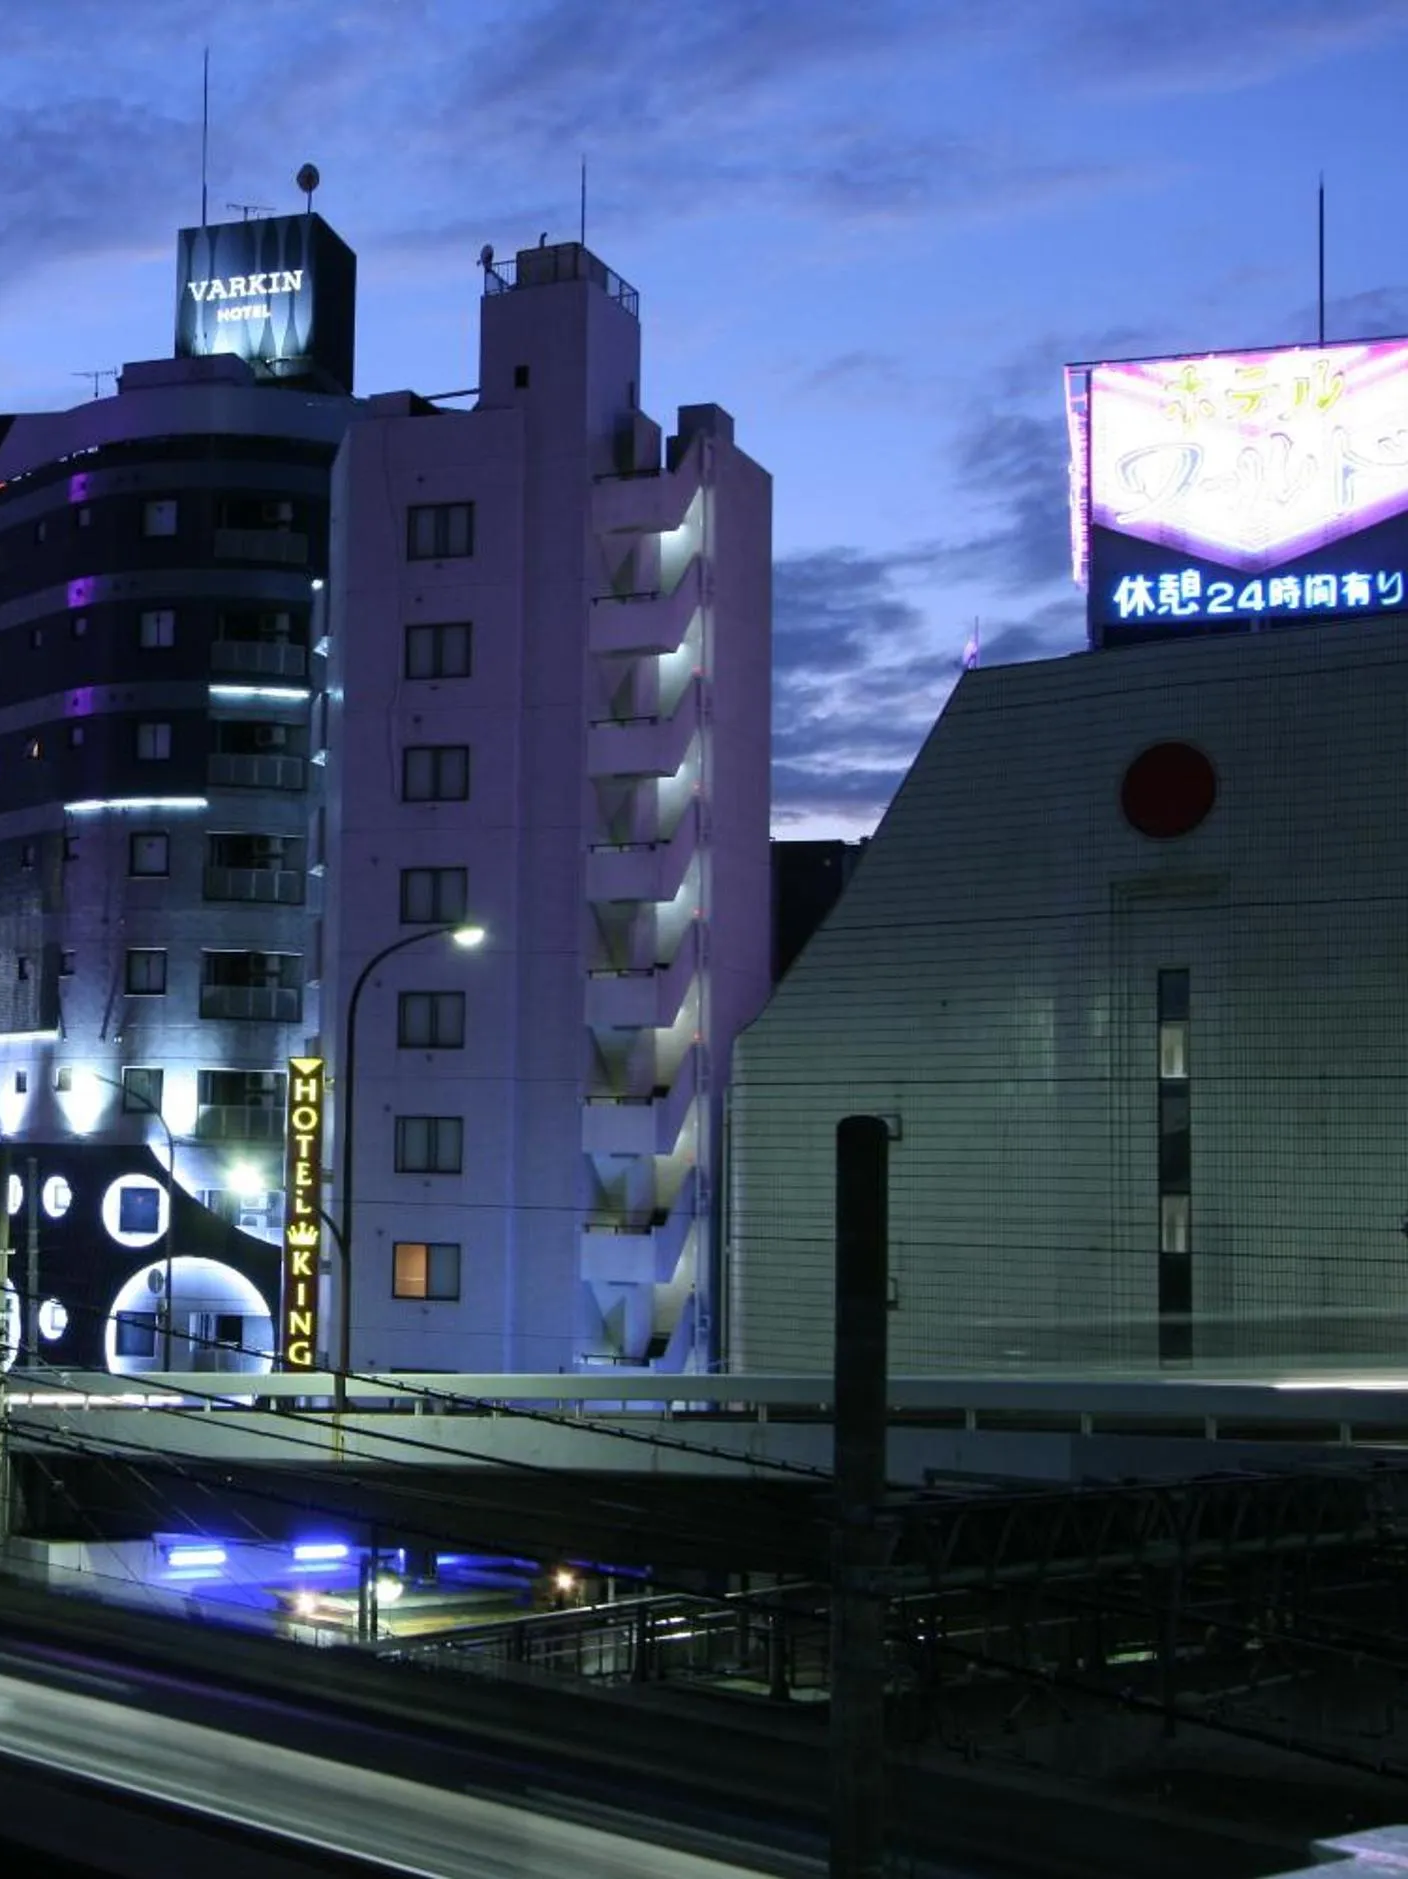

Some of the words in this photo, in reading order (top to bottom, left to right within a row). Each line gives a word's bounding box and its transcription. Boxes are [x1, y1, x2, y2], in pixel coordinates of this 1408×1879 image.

[187, 269, 304, 301] VARKIN
[216, 303, 271, 323] HOTEL
[1164, 358, 1345, 425] ホテル
[1112, 569, 1405, 618] 休憩24時間有り
[291, 1078, 318, 1213] HOTEL
[288, 1250, 314, 1367] KING
